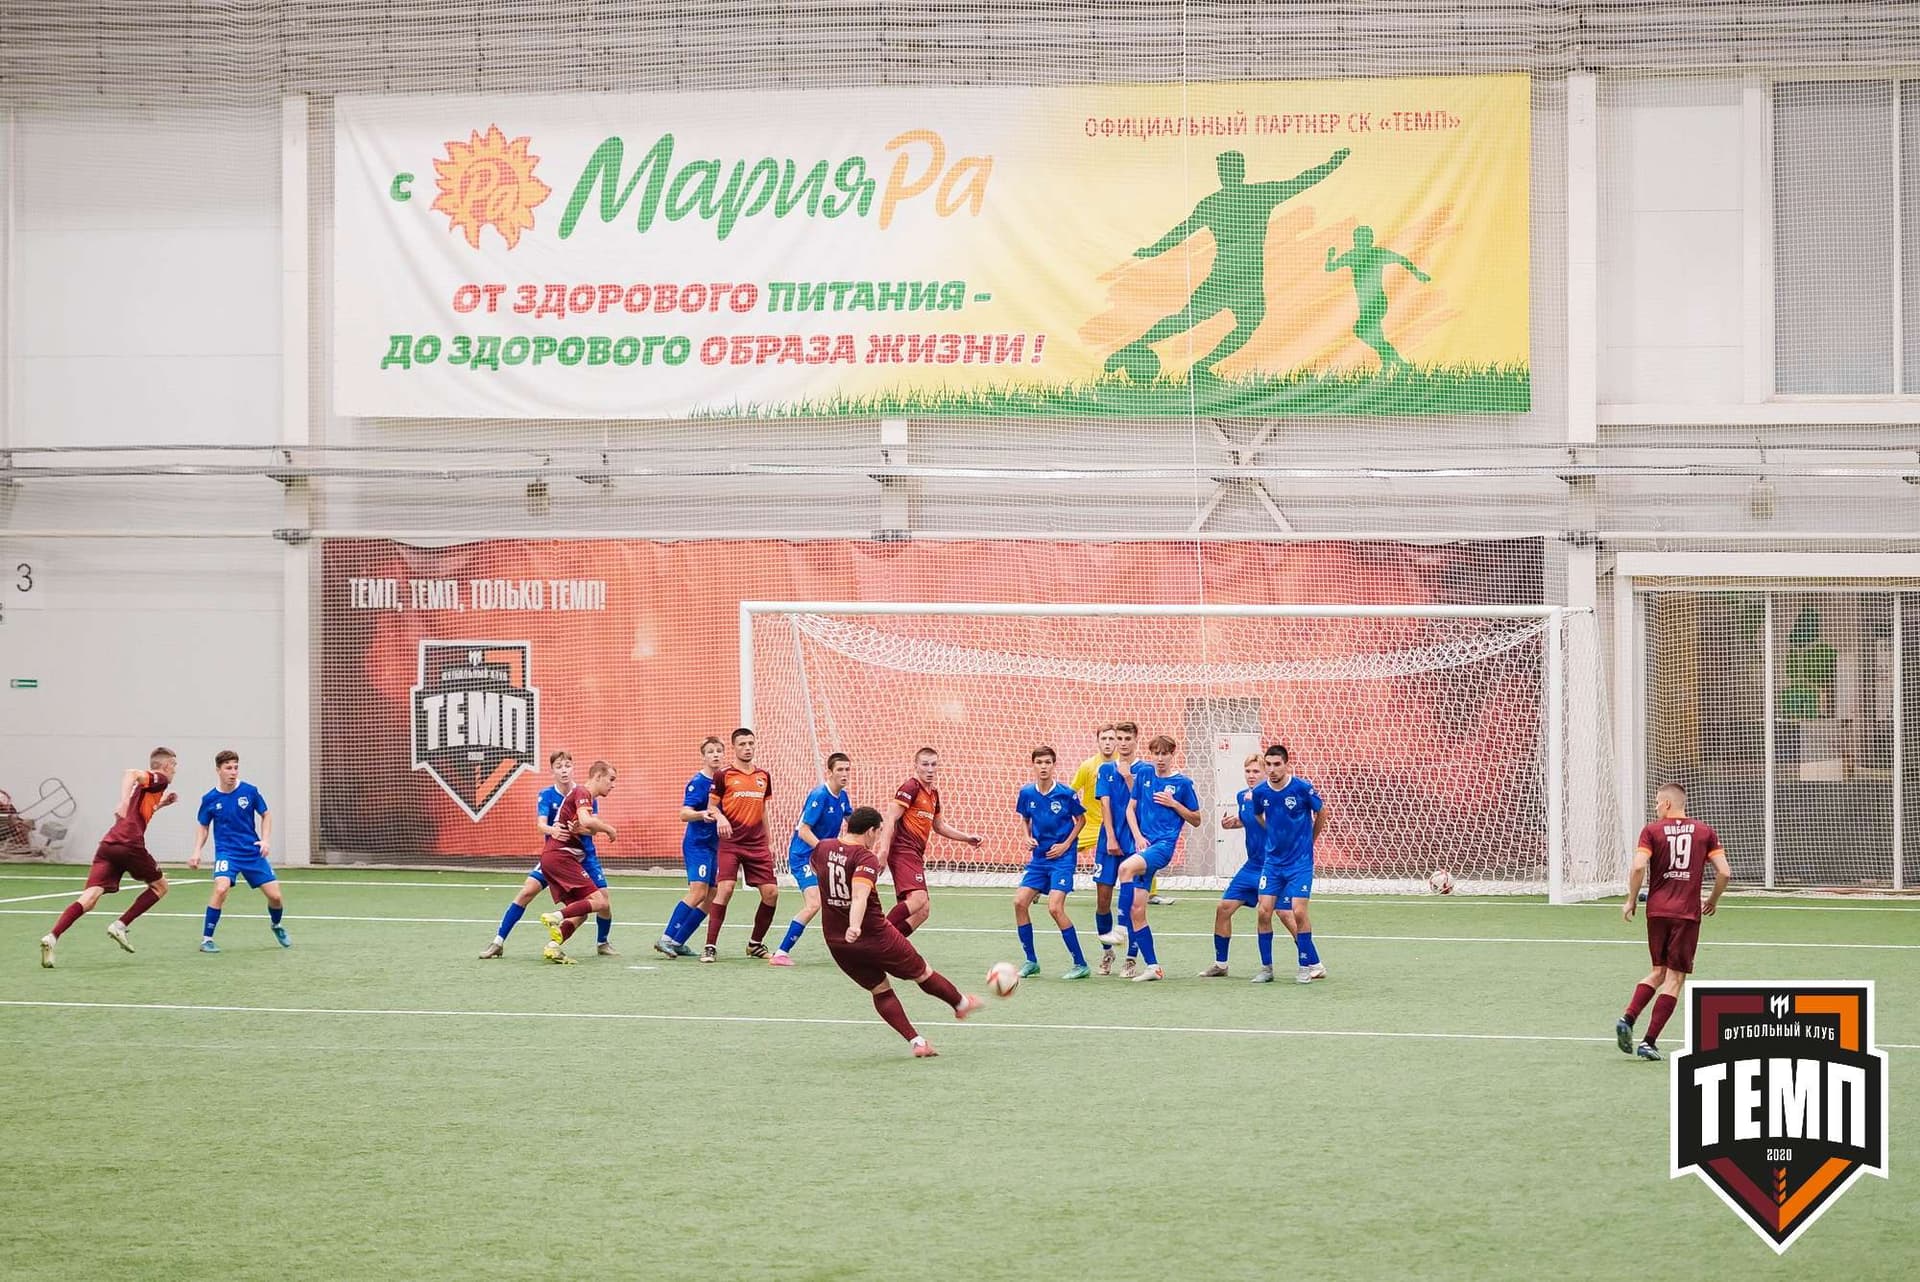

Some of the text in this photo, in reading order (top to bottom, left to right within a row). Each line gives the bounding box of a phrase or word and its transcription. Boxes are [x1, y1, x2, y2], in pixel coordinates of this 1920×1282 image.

[1085, 109, 1462, 143] ОФИЦИАЛЬНЫЙ ПАРТНЕР СК «ТЕМП»
[452, 283, 507, 314] ОТ
[512, 282, 759, 320] ЗДОРОВОГО
[767, 280, 968, 313] ПИТАНИЯ
[380, 334, 442, 371] ДО
[449, 335, 692, 372] ЗДОРОВОГО
[700, 334, 858, 366] ОБРАЗА
[16, 562, 33, 592] 3
[350, 577, 607, 613] ТЕМП, ТЕМП, ТОЛЬКО ТЕМП!
[423, 691, 528, 754] ТЕМП
[698, 864, 707, 878] 6
[1666, 833, 1693, 871] 19
[827, 861, 851, 900] 13
